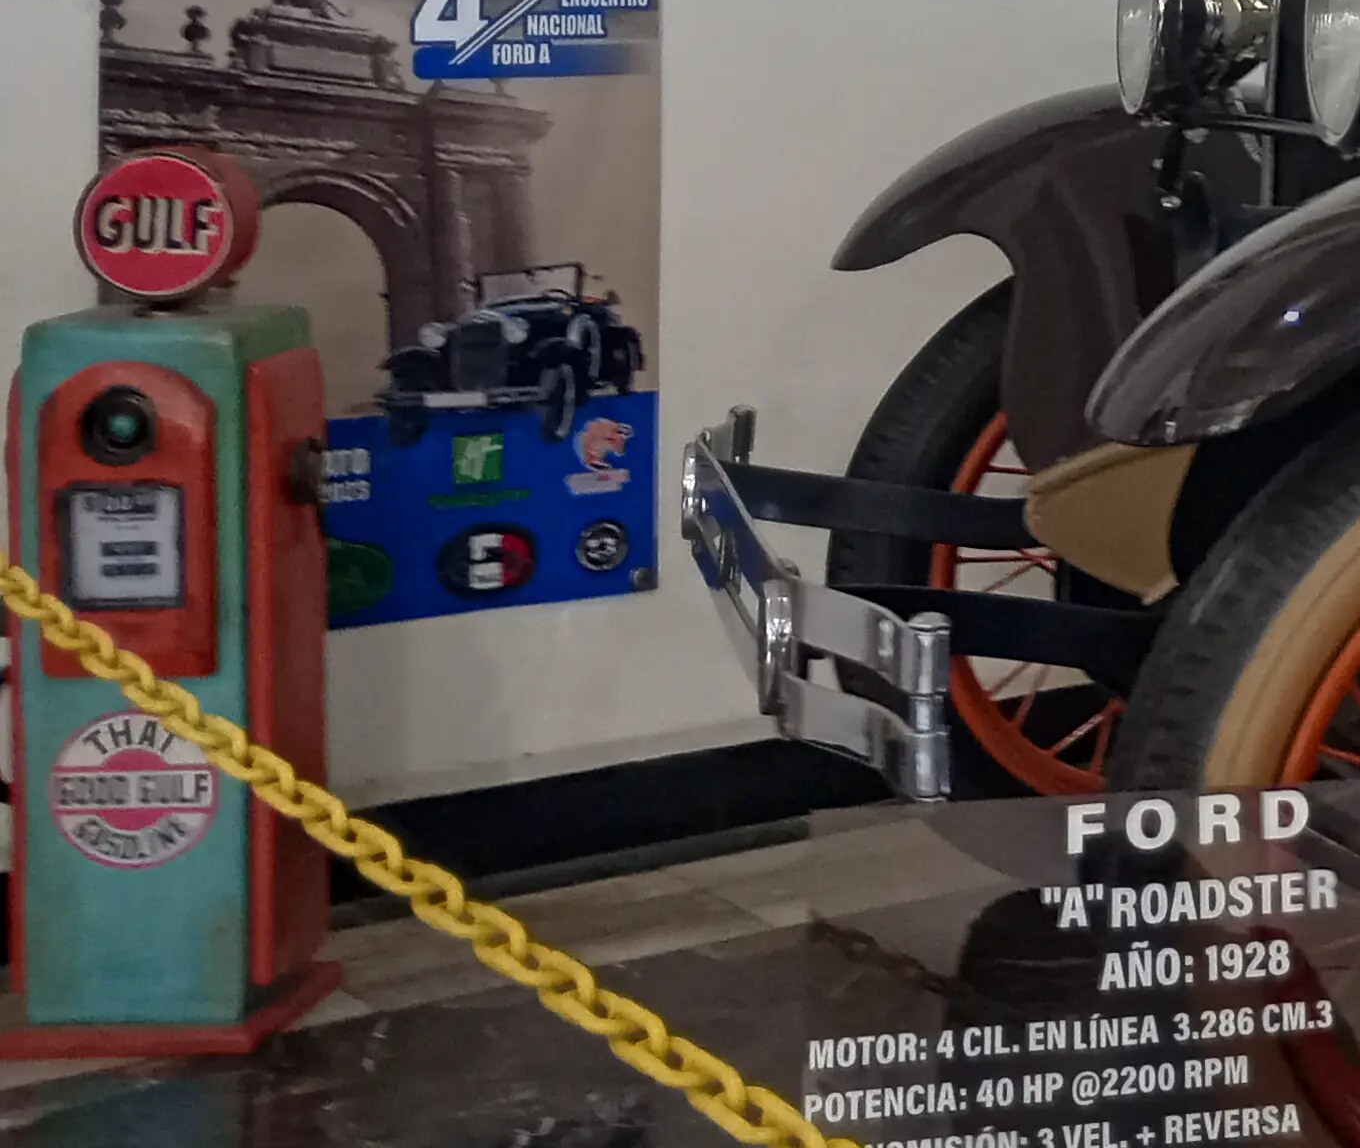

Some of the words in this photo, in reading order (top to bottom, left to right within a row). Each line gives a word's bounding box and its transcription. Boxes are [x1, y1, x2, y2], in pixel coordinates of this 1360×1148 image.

[492, 43, 535, 65] FORD
[539, 44, 551, 64] A
[527, 14, 604, 36] NACIONAL
[94, 195, 225, 255] GULF
[1066, 788, 1311, 854] FORD
[1111, 868, 1339, 928] ROADSTER
[1100, 940, 1195, 992] AÑO:
[1204, 939, 1291, 982] 1928
[808, 1032, 928, 1070] MOTOR:
[936, 1030, 956, 1059] 4
[962, 1024, 1021, 1056] CIL.
[1073, 1013, 1160, 1050] LÍNEA
[1173, 1007, 1256, 1042] 3.286
[1262, 1000, 1335, 1034] CM.3
[804, 1082, 968, 1125] POTENCIA:
[976, 1079, 1014, 1110] 40
[1022, 1072, 1064, 1105] HP
[1071, 1063, 1177, 1108] @2200
[1183, 1055, 1250, 1090] RPM
[1164, 1104, 1302, 1144] REVERSA
